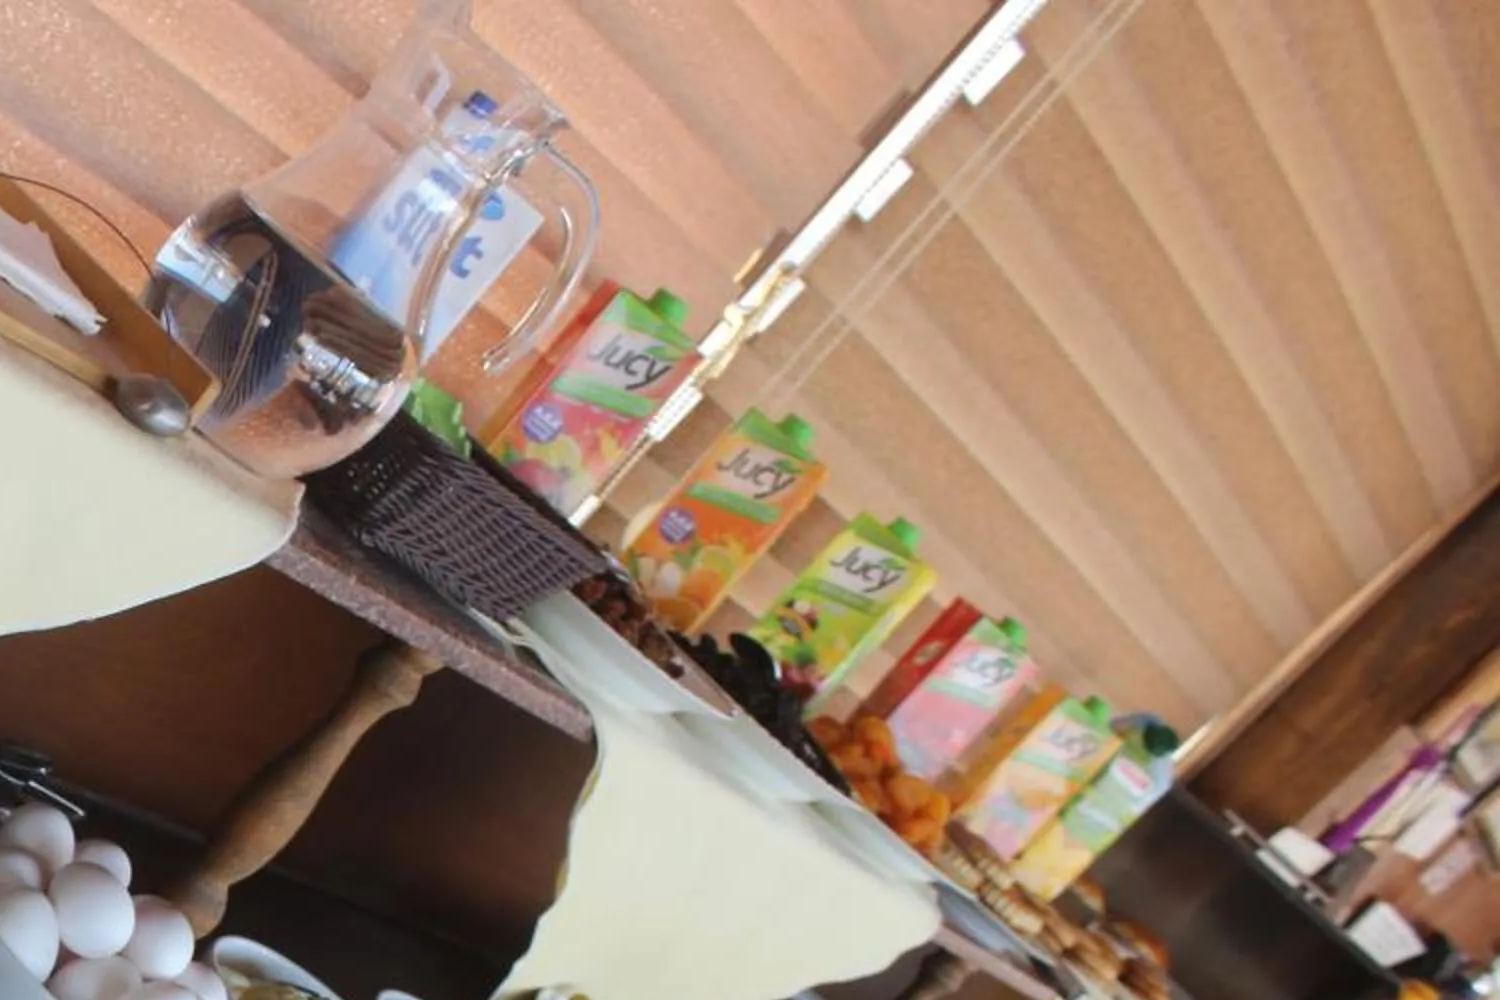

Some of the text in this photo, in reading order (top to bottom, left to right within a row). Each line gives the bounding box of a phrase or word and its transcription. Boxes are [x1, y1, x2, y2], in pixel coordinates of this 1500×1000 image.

[588, 333, 674, 391] Jucy
[716, 447, 796, 499] Jucy
[830, 546, 902, 593] Jucy
